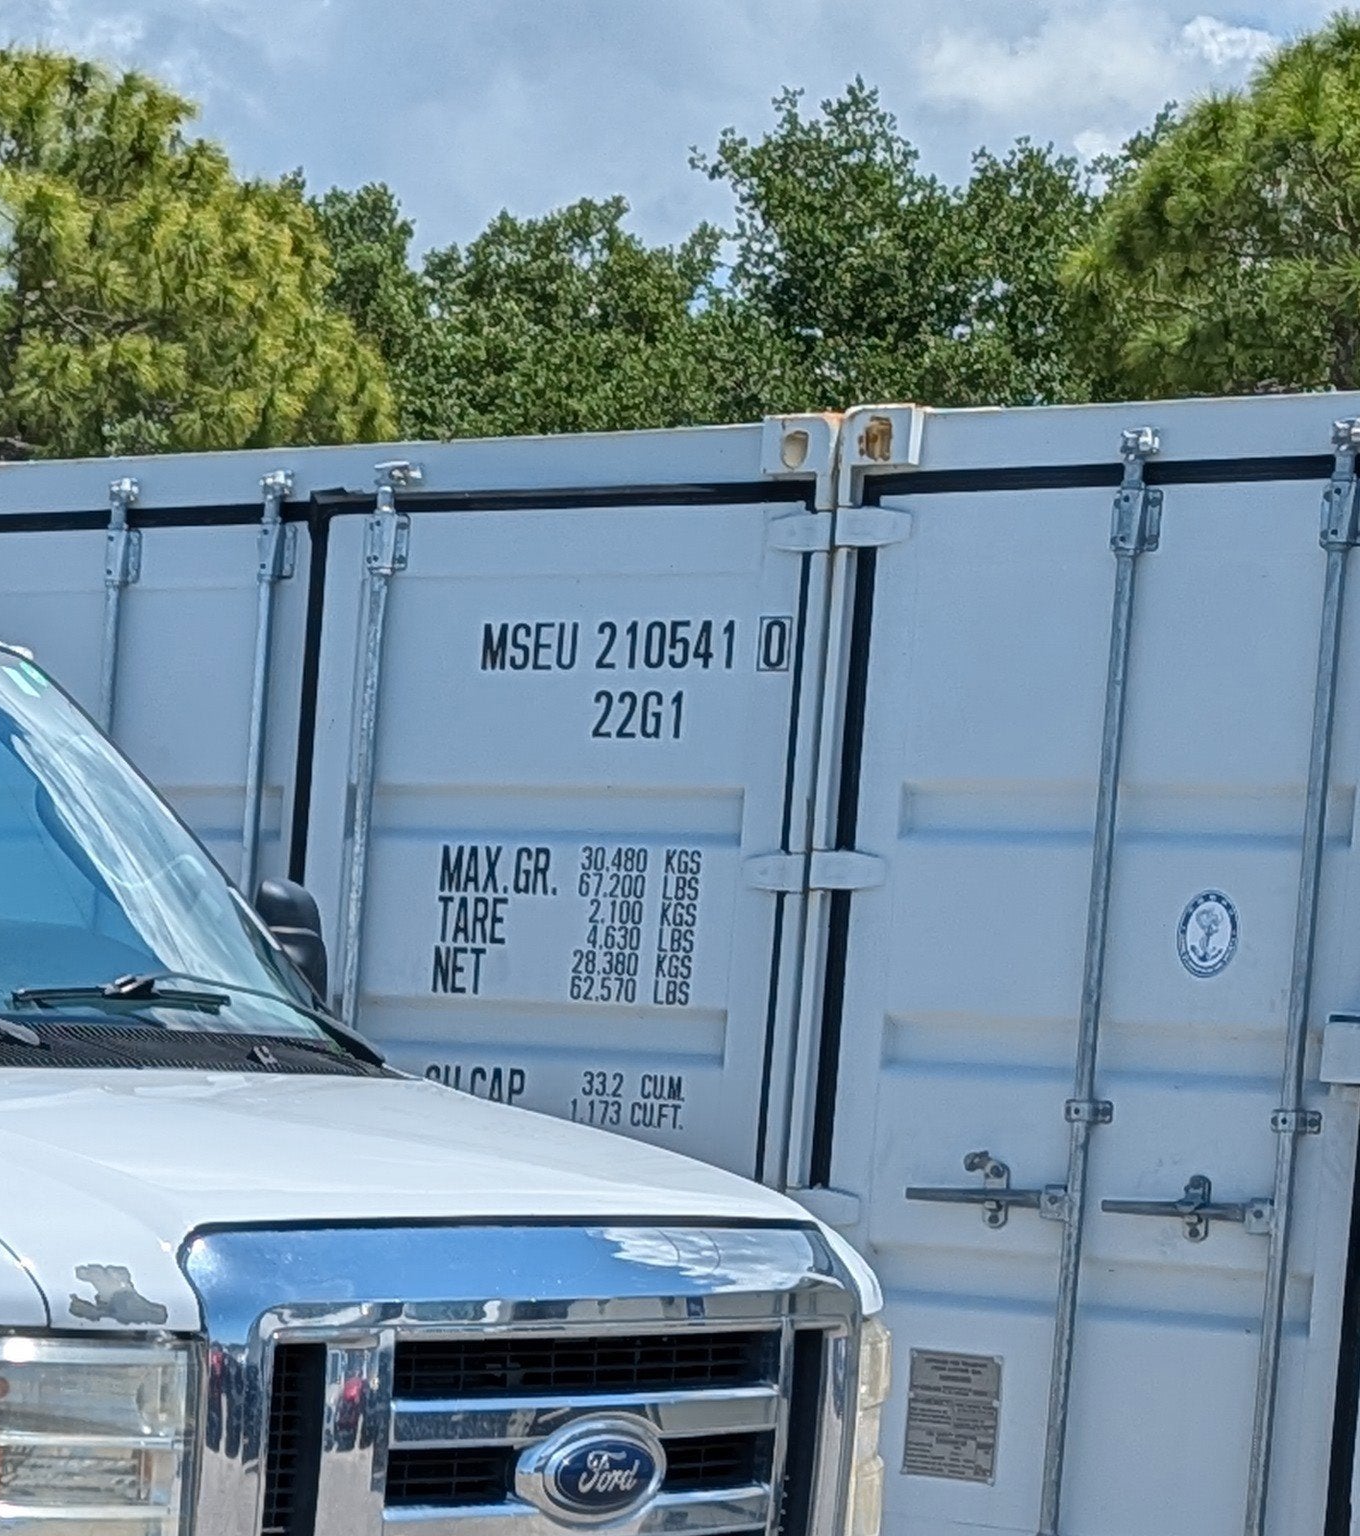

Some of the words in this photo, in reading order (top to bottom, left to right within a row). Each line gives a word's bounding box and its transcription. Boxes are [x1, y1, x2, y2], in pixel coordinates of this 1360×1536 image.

[480, 622, 579, 670] MSEU
[594, 619, 735, 669] 210541
[761, 619, 788, 669] 0
[591, 690, 684, 739] 22G1
[438, 845, 558, 896] MAX.GR.
[581, 846, 648, 873] 30.480
[665, 849, 702, 875] KGS
[578, 872, 646, 899] 67.200
[662, 875, 699, 901] LBS
[438, 897, 509, 945] TARE
[588, 898, 643, 925] 2.100
[660, 902, 697, 927] KGS
[586, 924, 641, 950] 4.630
[657, 927, 695, 953] LBS
[431, 947, 486, 994] NET
[571, 949, 639, 977] 28.380
[655, 953, 693, 979] KGS
[569, 975, 637, 1003] 62.570
[653, 979, 691, 1006] LBS
[581, 1071, 624, 1098] 33.2
[578, 1450, 641, 1493] Ford
